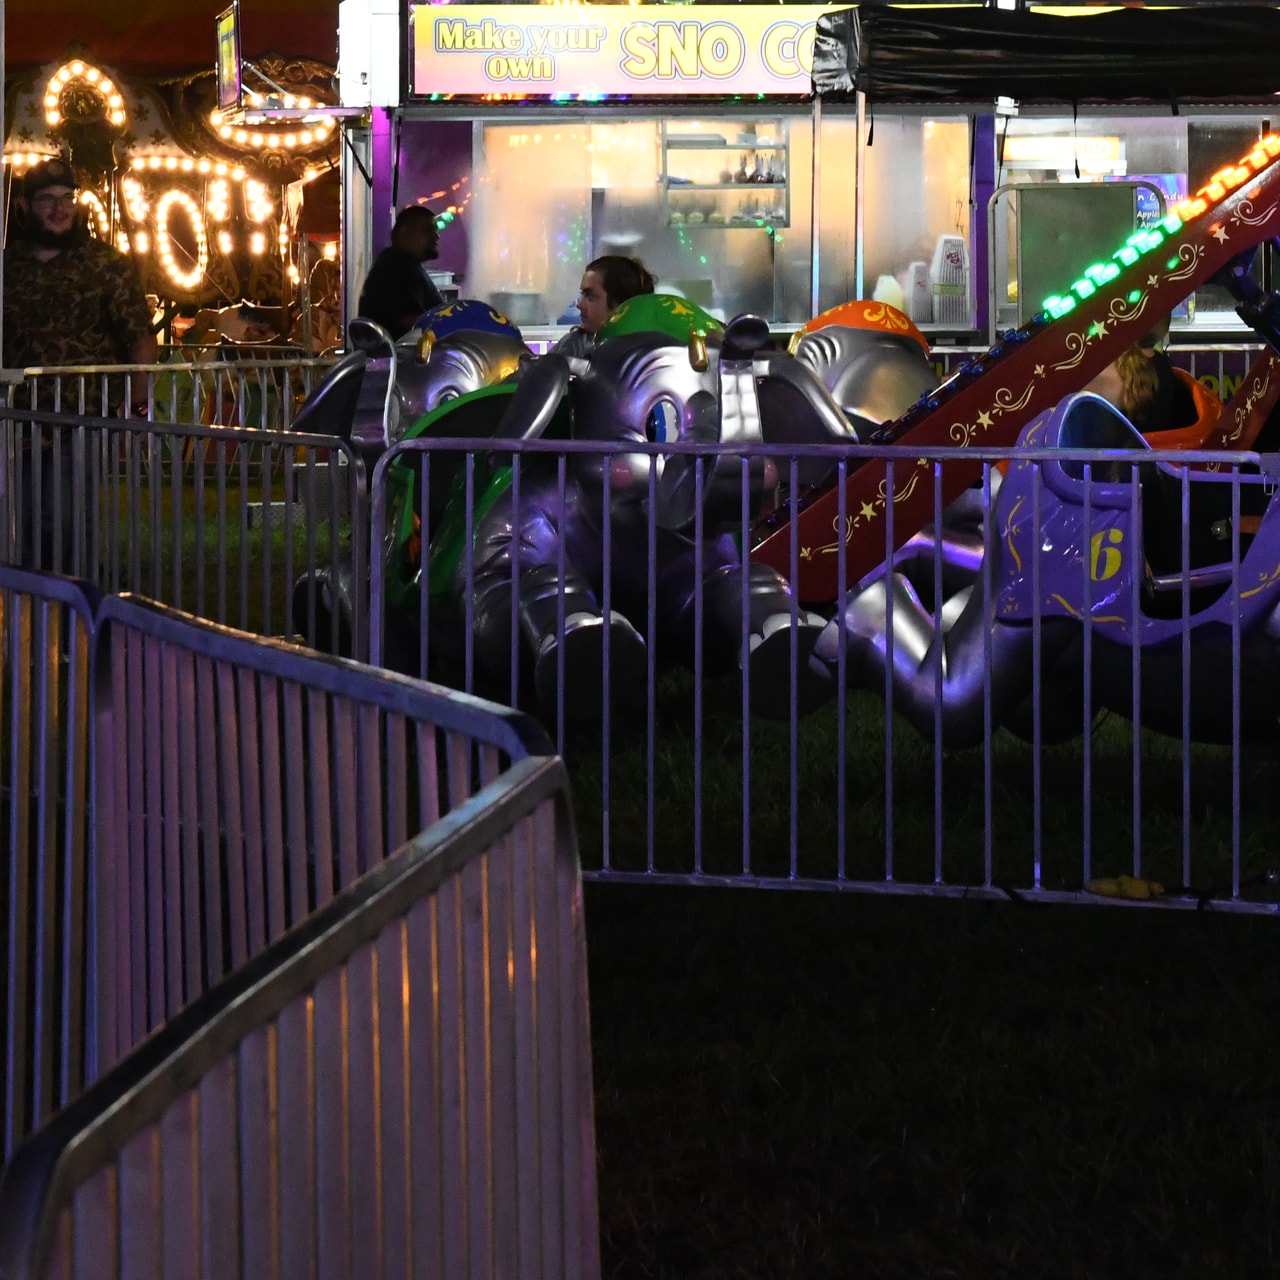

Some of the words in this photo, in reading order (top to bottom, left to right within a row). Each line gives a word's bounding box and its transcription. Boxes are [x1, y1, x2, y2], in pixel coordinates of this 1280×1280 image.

[436, 20, 523, 51] Make
[528, 24, 606, 56] your
[622, 23, 744, 77] SNO
[487, 55, 554, 80] own
[1089, 528, 1124, 581] 6
